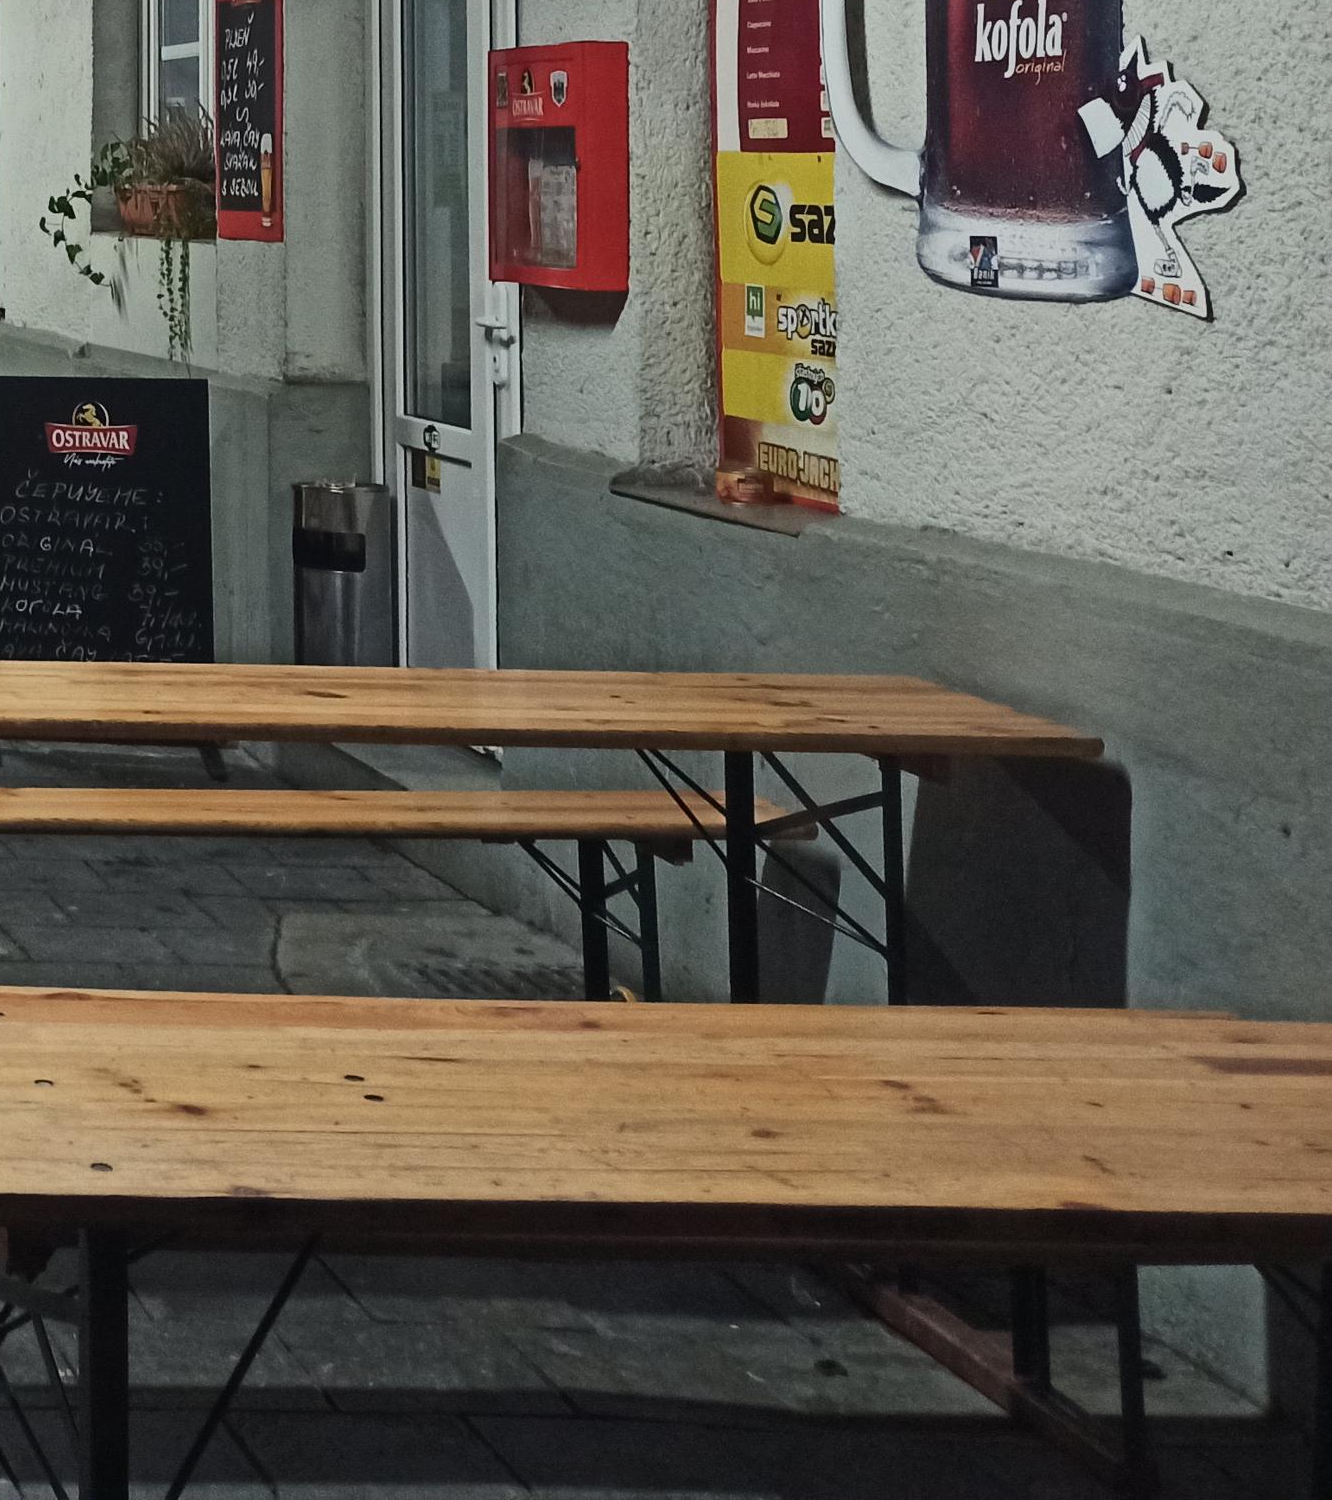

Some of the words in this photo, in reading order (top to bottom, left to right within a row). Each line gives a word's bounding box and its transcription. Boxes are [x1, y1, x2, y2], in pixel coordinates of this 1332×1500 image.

[1015, 50, 1067, 86] original
[512, 96, 544, 116] OSTRAVAR
[748, 290, 762, 311] hi
[798, 381, 825, 418] 10
[52, 428, 131, 451] OSTRAVAR
